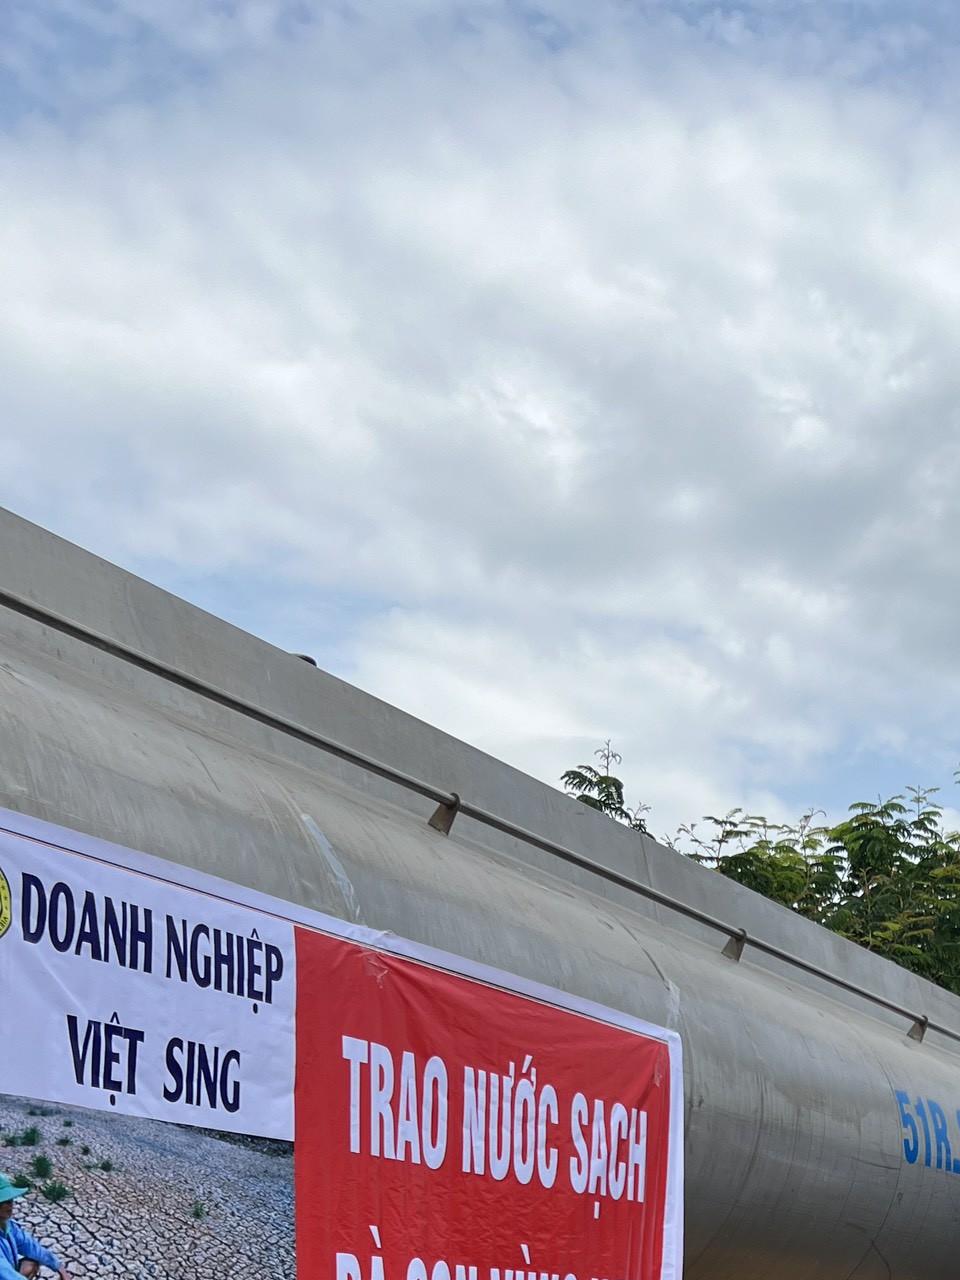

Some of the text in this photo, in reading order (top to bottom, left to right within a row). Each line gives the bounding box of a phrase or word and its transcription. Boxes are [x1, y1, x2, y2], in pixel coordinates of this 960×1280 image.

[21, 872, 283, 1013] DOANH NGHIỆP
[67, 1013, 241, 1112] VIỆT SING
[342, 1036, 647, 1219] TRAO NƯỚC SẠCH
